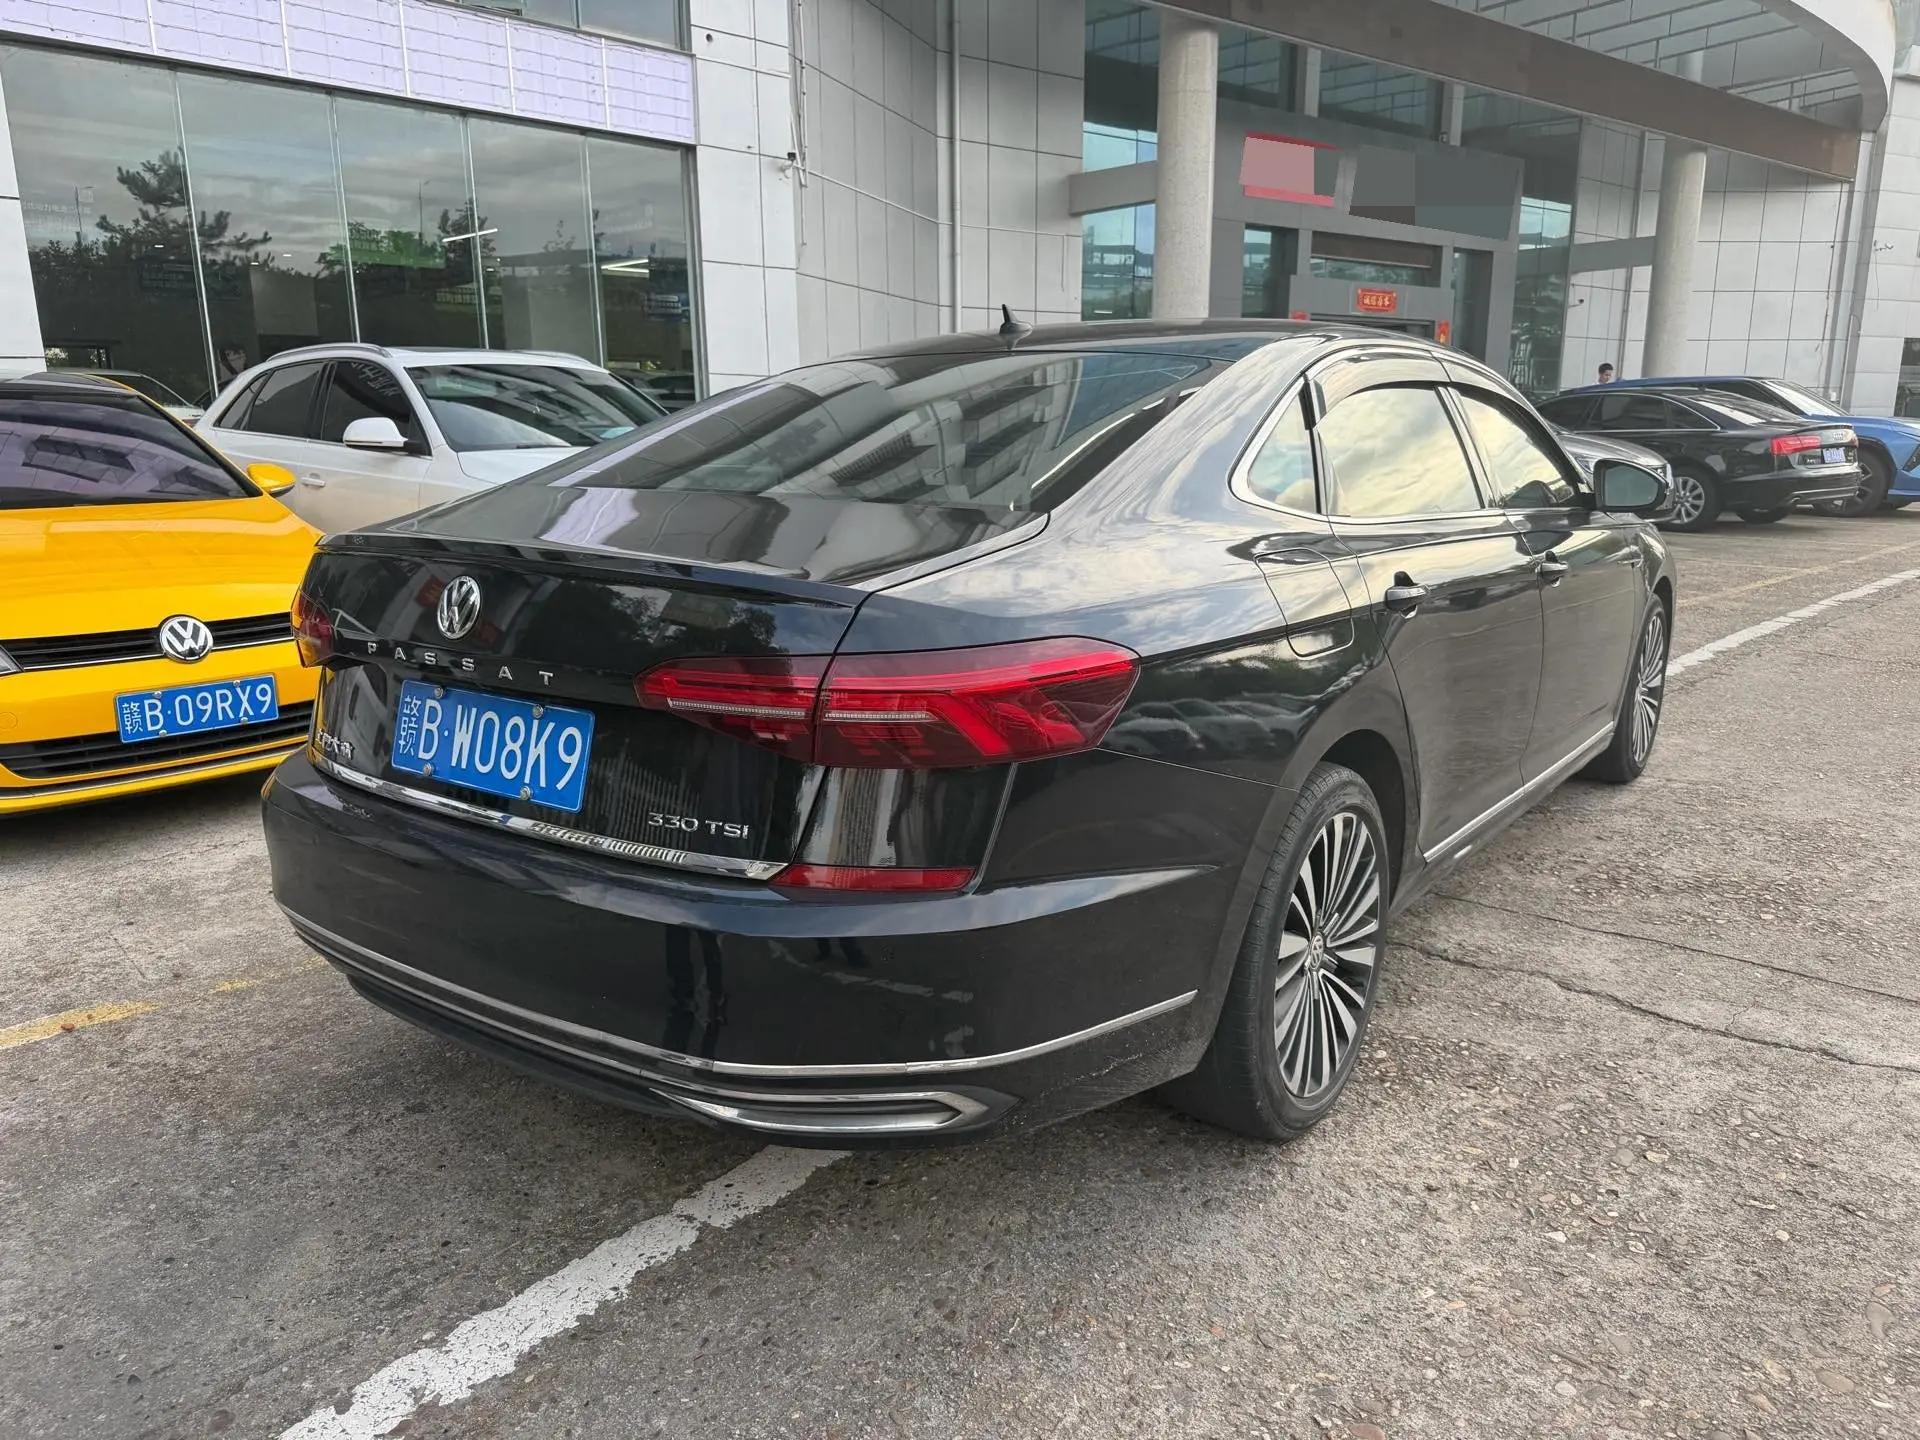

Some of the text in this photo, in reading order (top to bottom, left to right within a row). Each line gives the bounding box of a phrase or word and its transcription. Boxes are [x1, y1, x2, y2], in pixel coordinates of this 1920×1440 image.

[367, 641, 554, 686] PASSAT
[648, 812, 750, 840] 330 TSI
